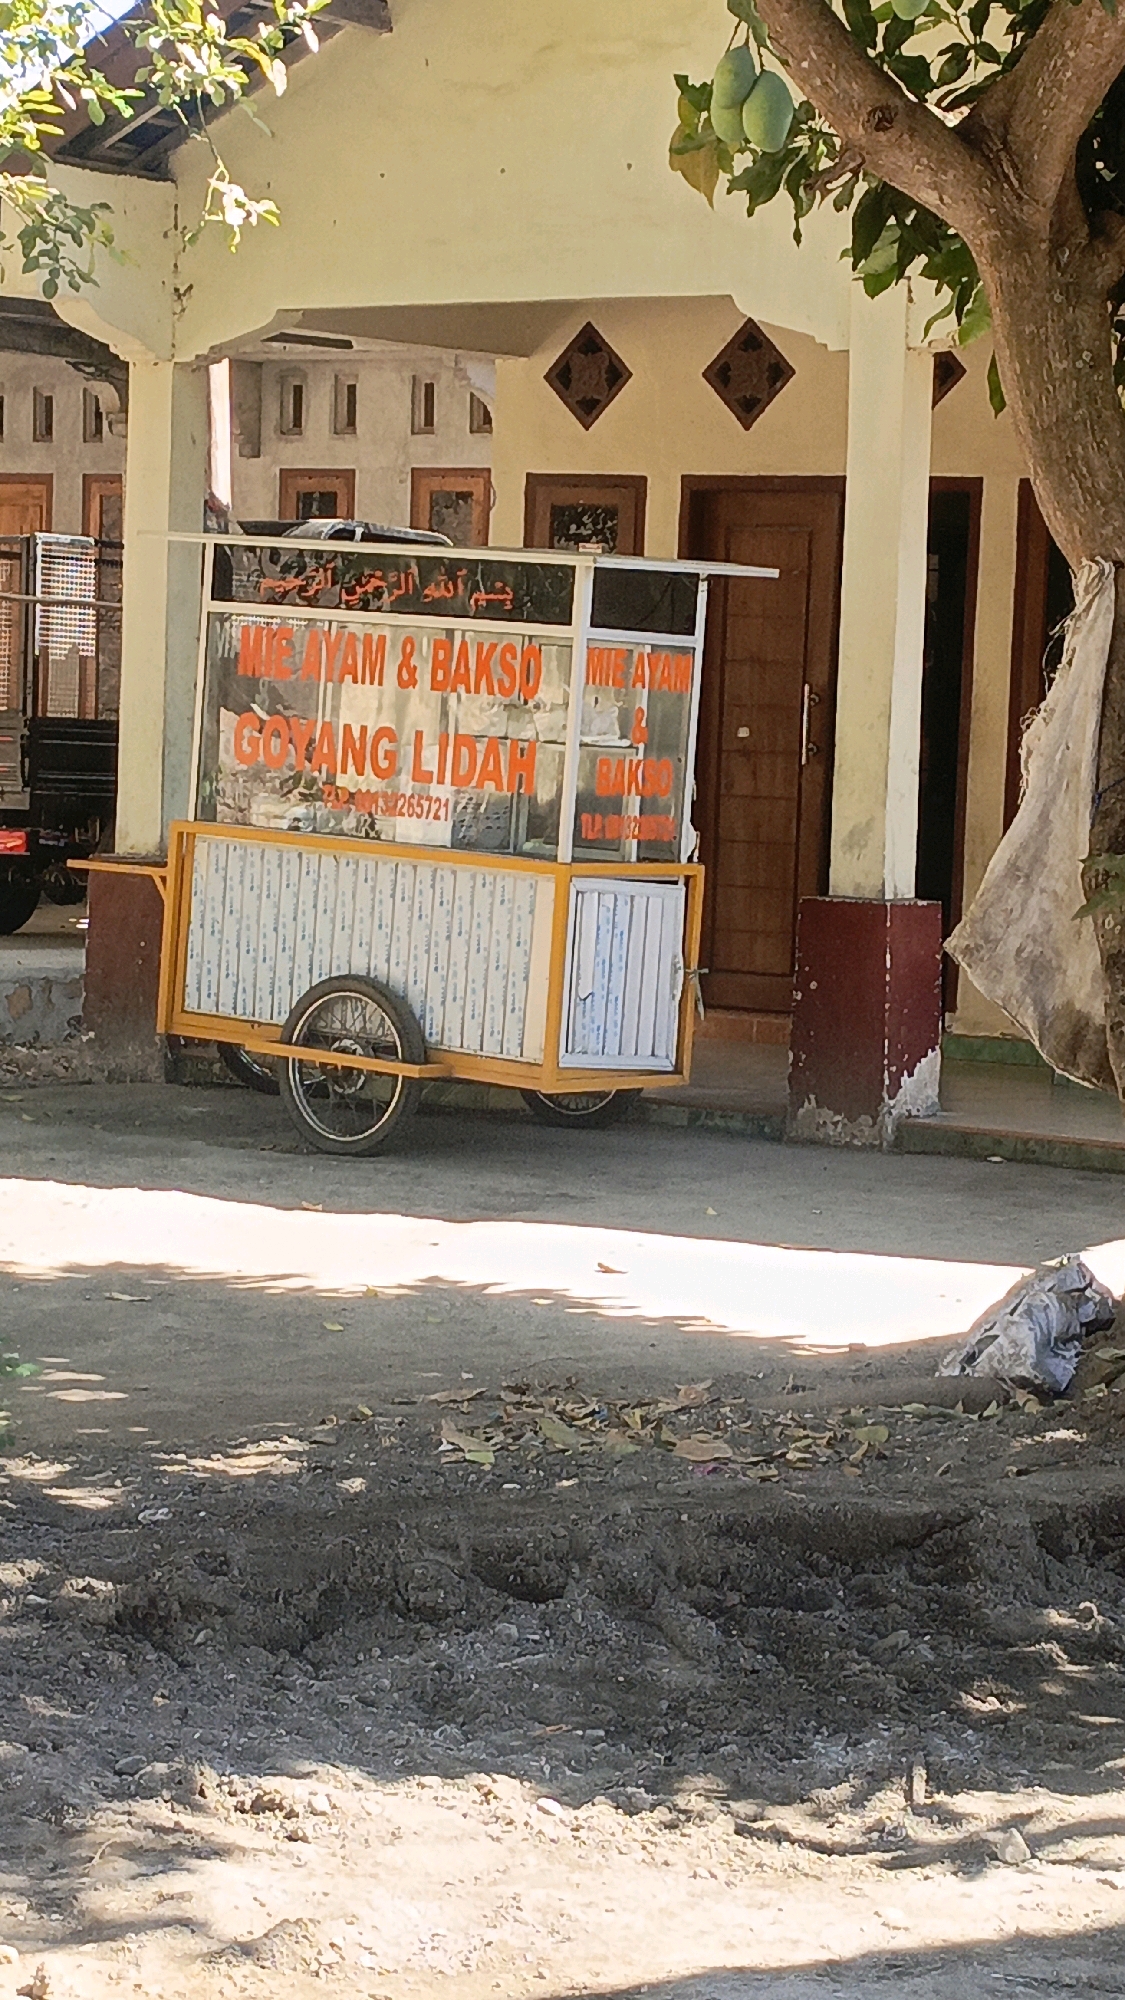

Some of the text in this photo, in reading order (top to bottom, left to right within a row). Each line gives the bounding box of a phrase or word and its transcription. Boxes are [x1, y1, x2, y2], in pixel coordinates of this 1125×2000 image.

[237, 625, 543, 700] MIE AYAM & BAKSO
[585, 647, 693, 694] MIE AYAM
[631, 706, 649, 744] &
[233, 712, 537, 797] GOYANG LIDAH
[595, 757, 674, 798] BAKSO
